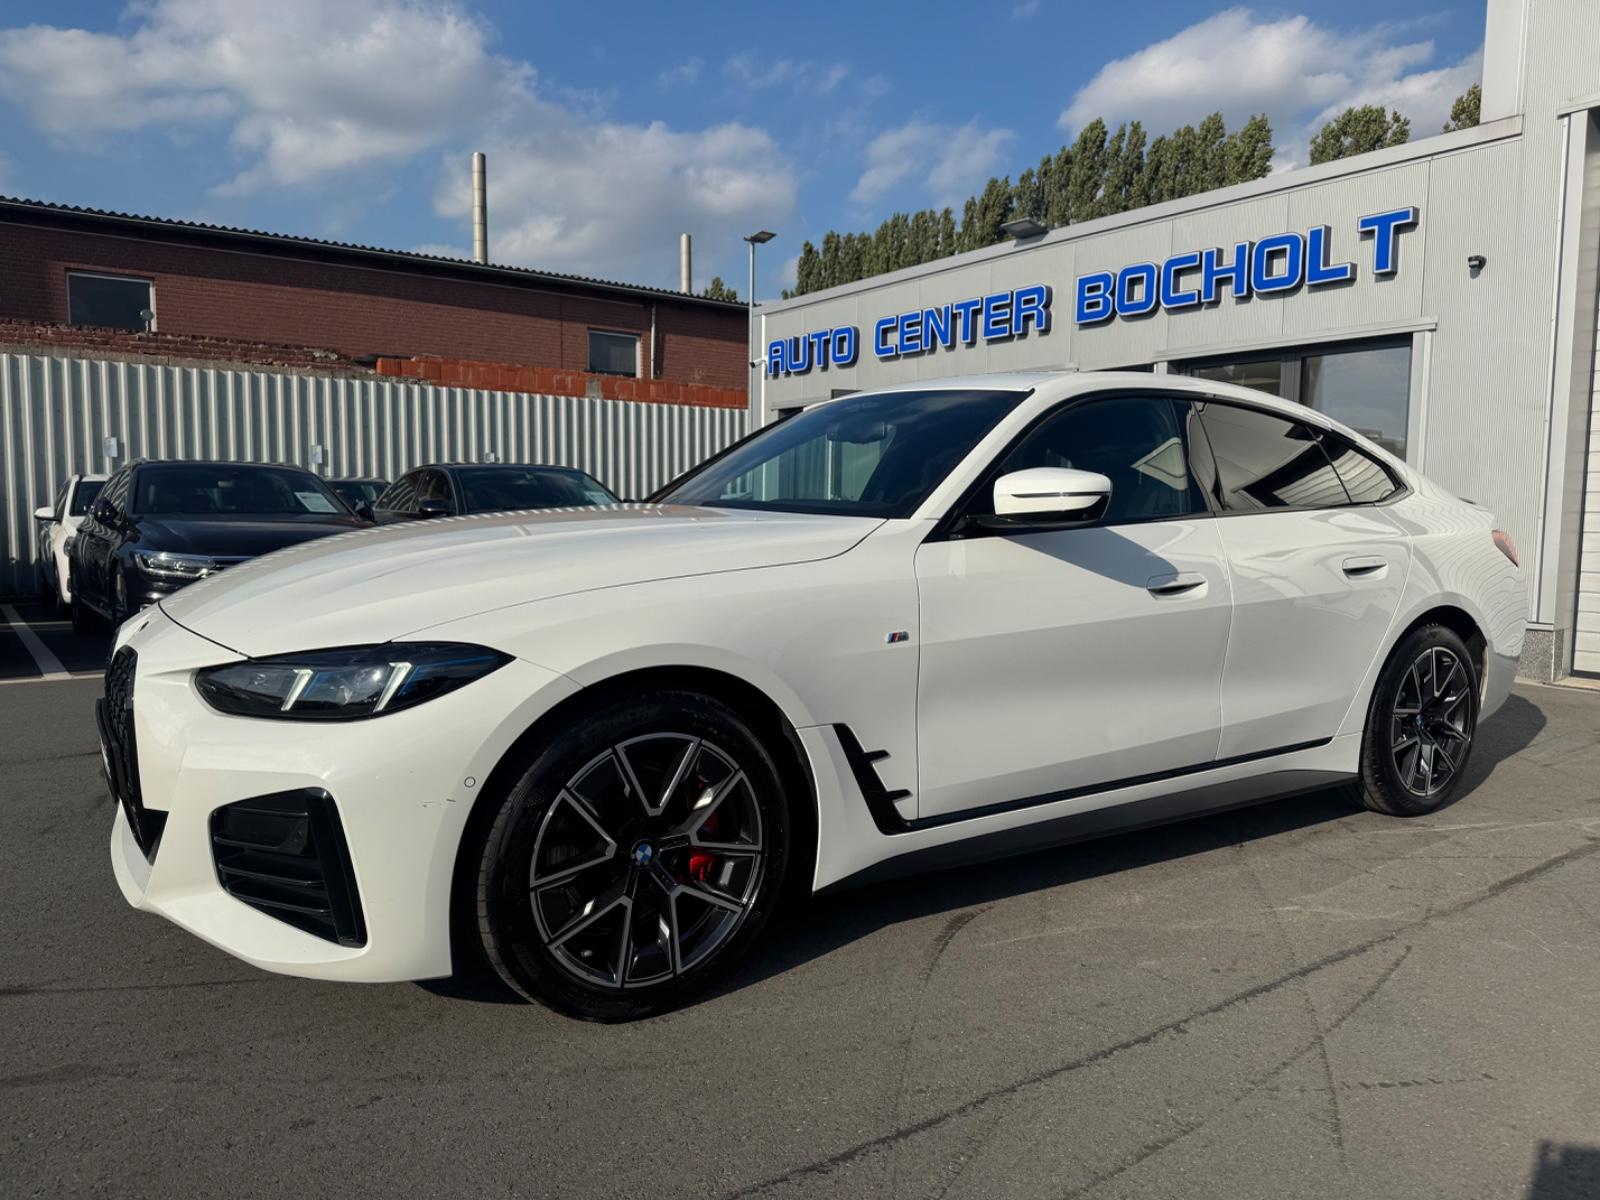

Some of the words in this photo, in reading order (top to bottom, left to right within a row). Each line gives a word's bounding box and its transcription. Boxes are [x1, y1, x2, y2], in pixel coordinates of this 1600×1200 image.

[767, 325, 857, 375] AUTO
[873, 283, 1050, 358] CENTER
[1075, 207, 1417, 324] BOCHOLT
